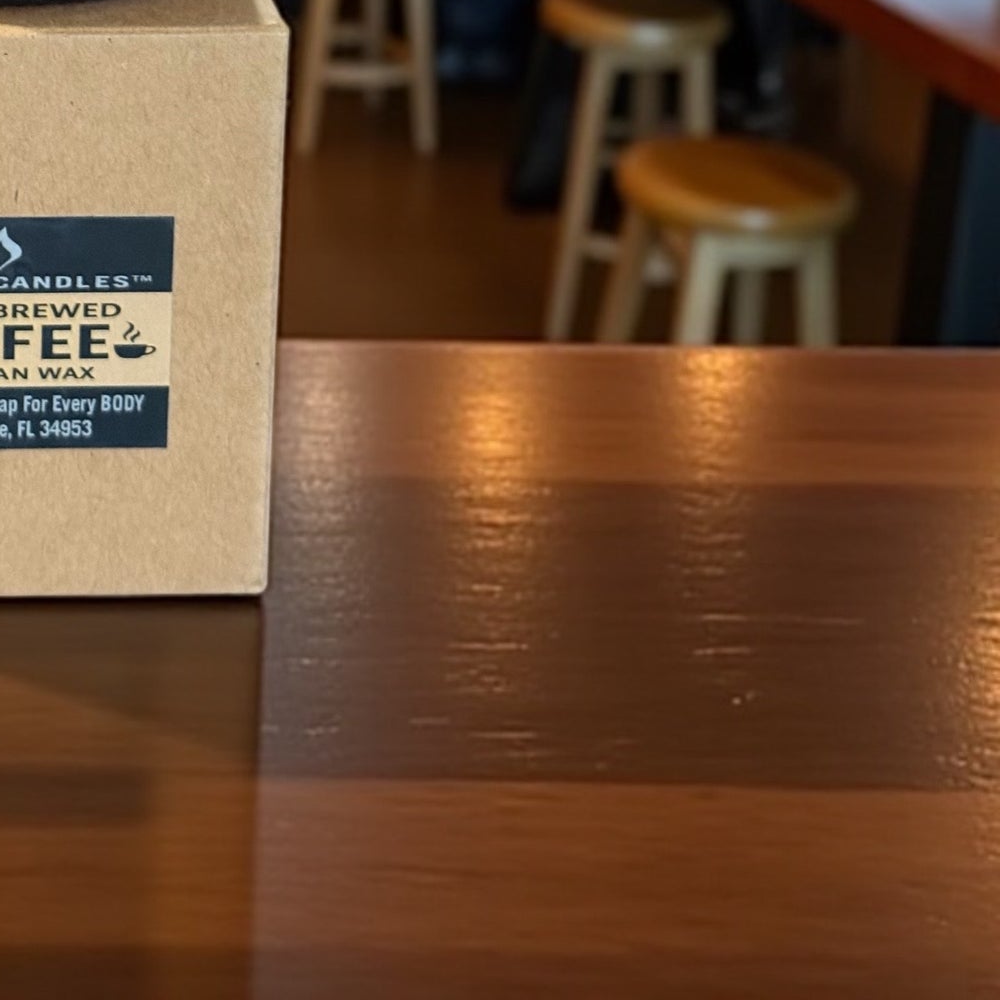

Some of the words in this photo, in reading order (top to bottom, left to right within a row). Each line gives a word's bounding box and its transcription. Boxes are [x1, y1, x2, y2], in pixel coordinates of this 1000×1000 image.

[38, 367, 95, 380] WAX
[23, 395, 48, 413] For
[52, 395, 96, 416] Every
[100, 394, 145, 413] BODY
[17, 421, 35, 438] FL
[39, 420, 92, 437] 34953
